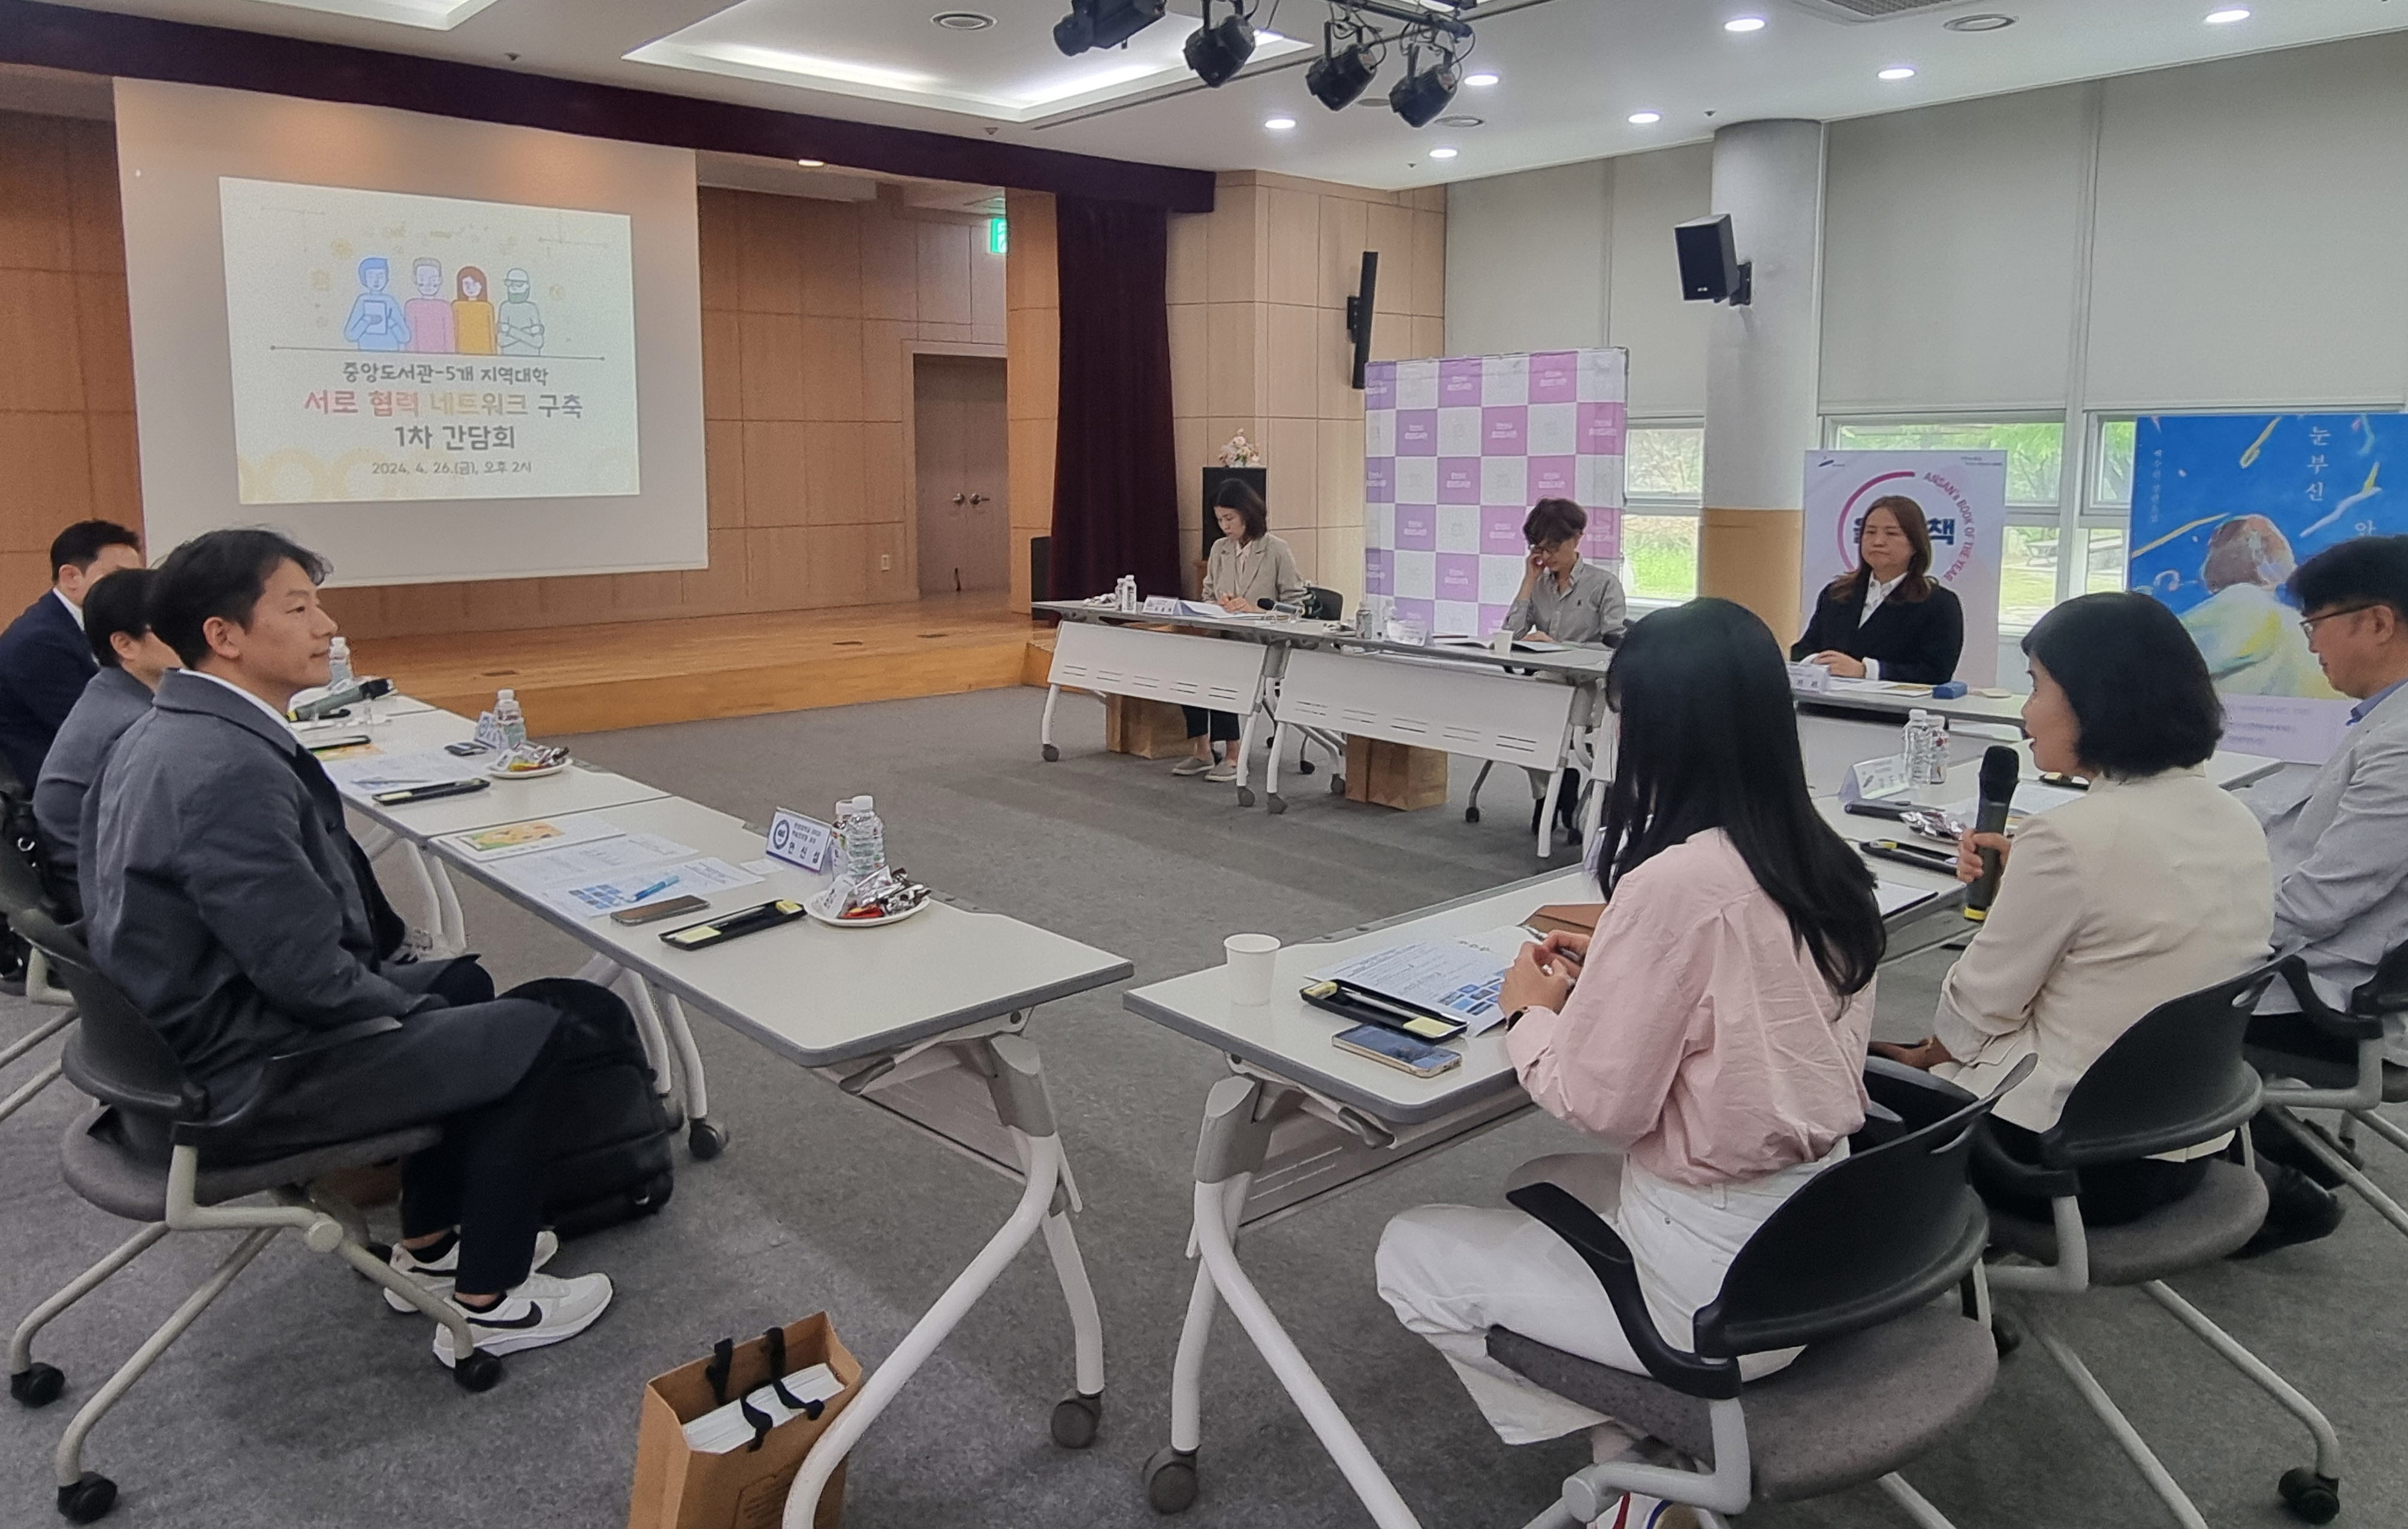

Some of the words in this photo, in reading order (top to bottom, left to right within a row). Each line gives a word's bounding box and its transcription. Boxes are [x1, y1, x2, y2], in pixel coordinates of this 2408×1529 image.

[343, 362, 474, 384] 중앙도서관-5개
[480, 366, 549, 386] 지역대학
[304, 390, 359, 415] 서로
[368, 390, 419, 417] 협력
[429, 391, 529, 416] 네트워크
[538, 394, 583, 419] 구축
[394, 425, 433, 450] 1차
[442, 424, 515, 451] 간담회
[484, 461, 508, 474] 오후
[512, 461, 532, 474] 2시
[2306, 426, 2332, 502] 눈부신
[1956, 499, 1975, 525] BOOK
[1927, 517, 1956, 546] 책
[1964, 526, 1975, 539] OF
[1959, 541, 1974, 559] THE
[1942, 559, 1967, 582] YEAR
